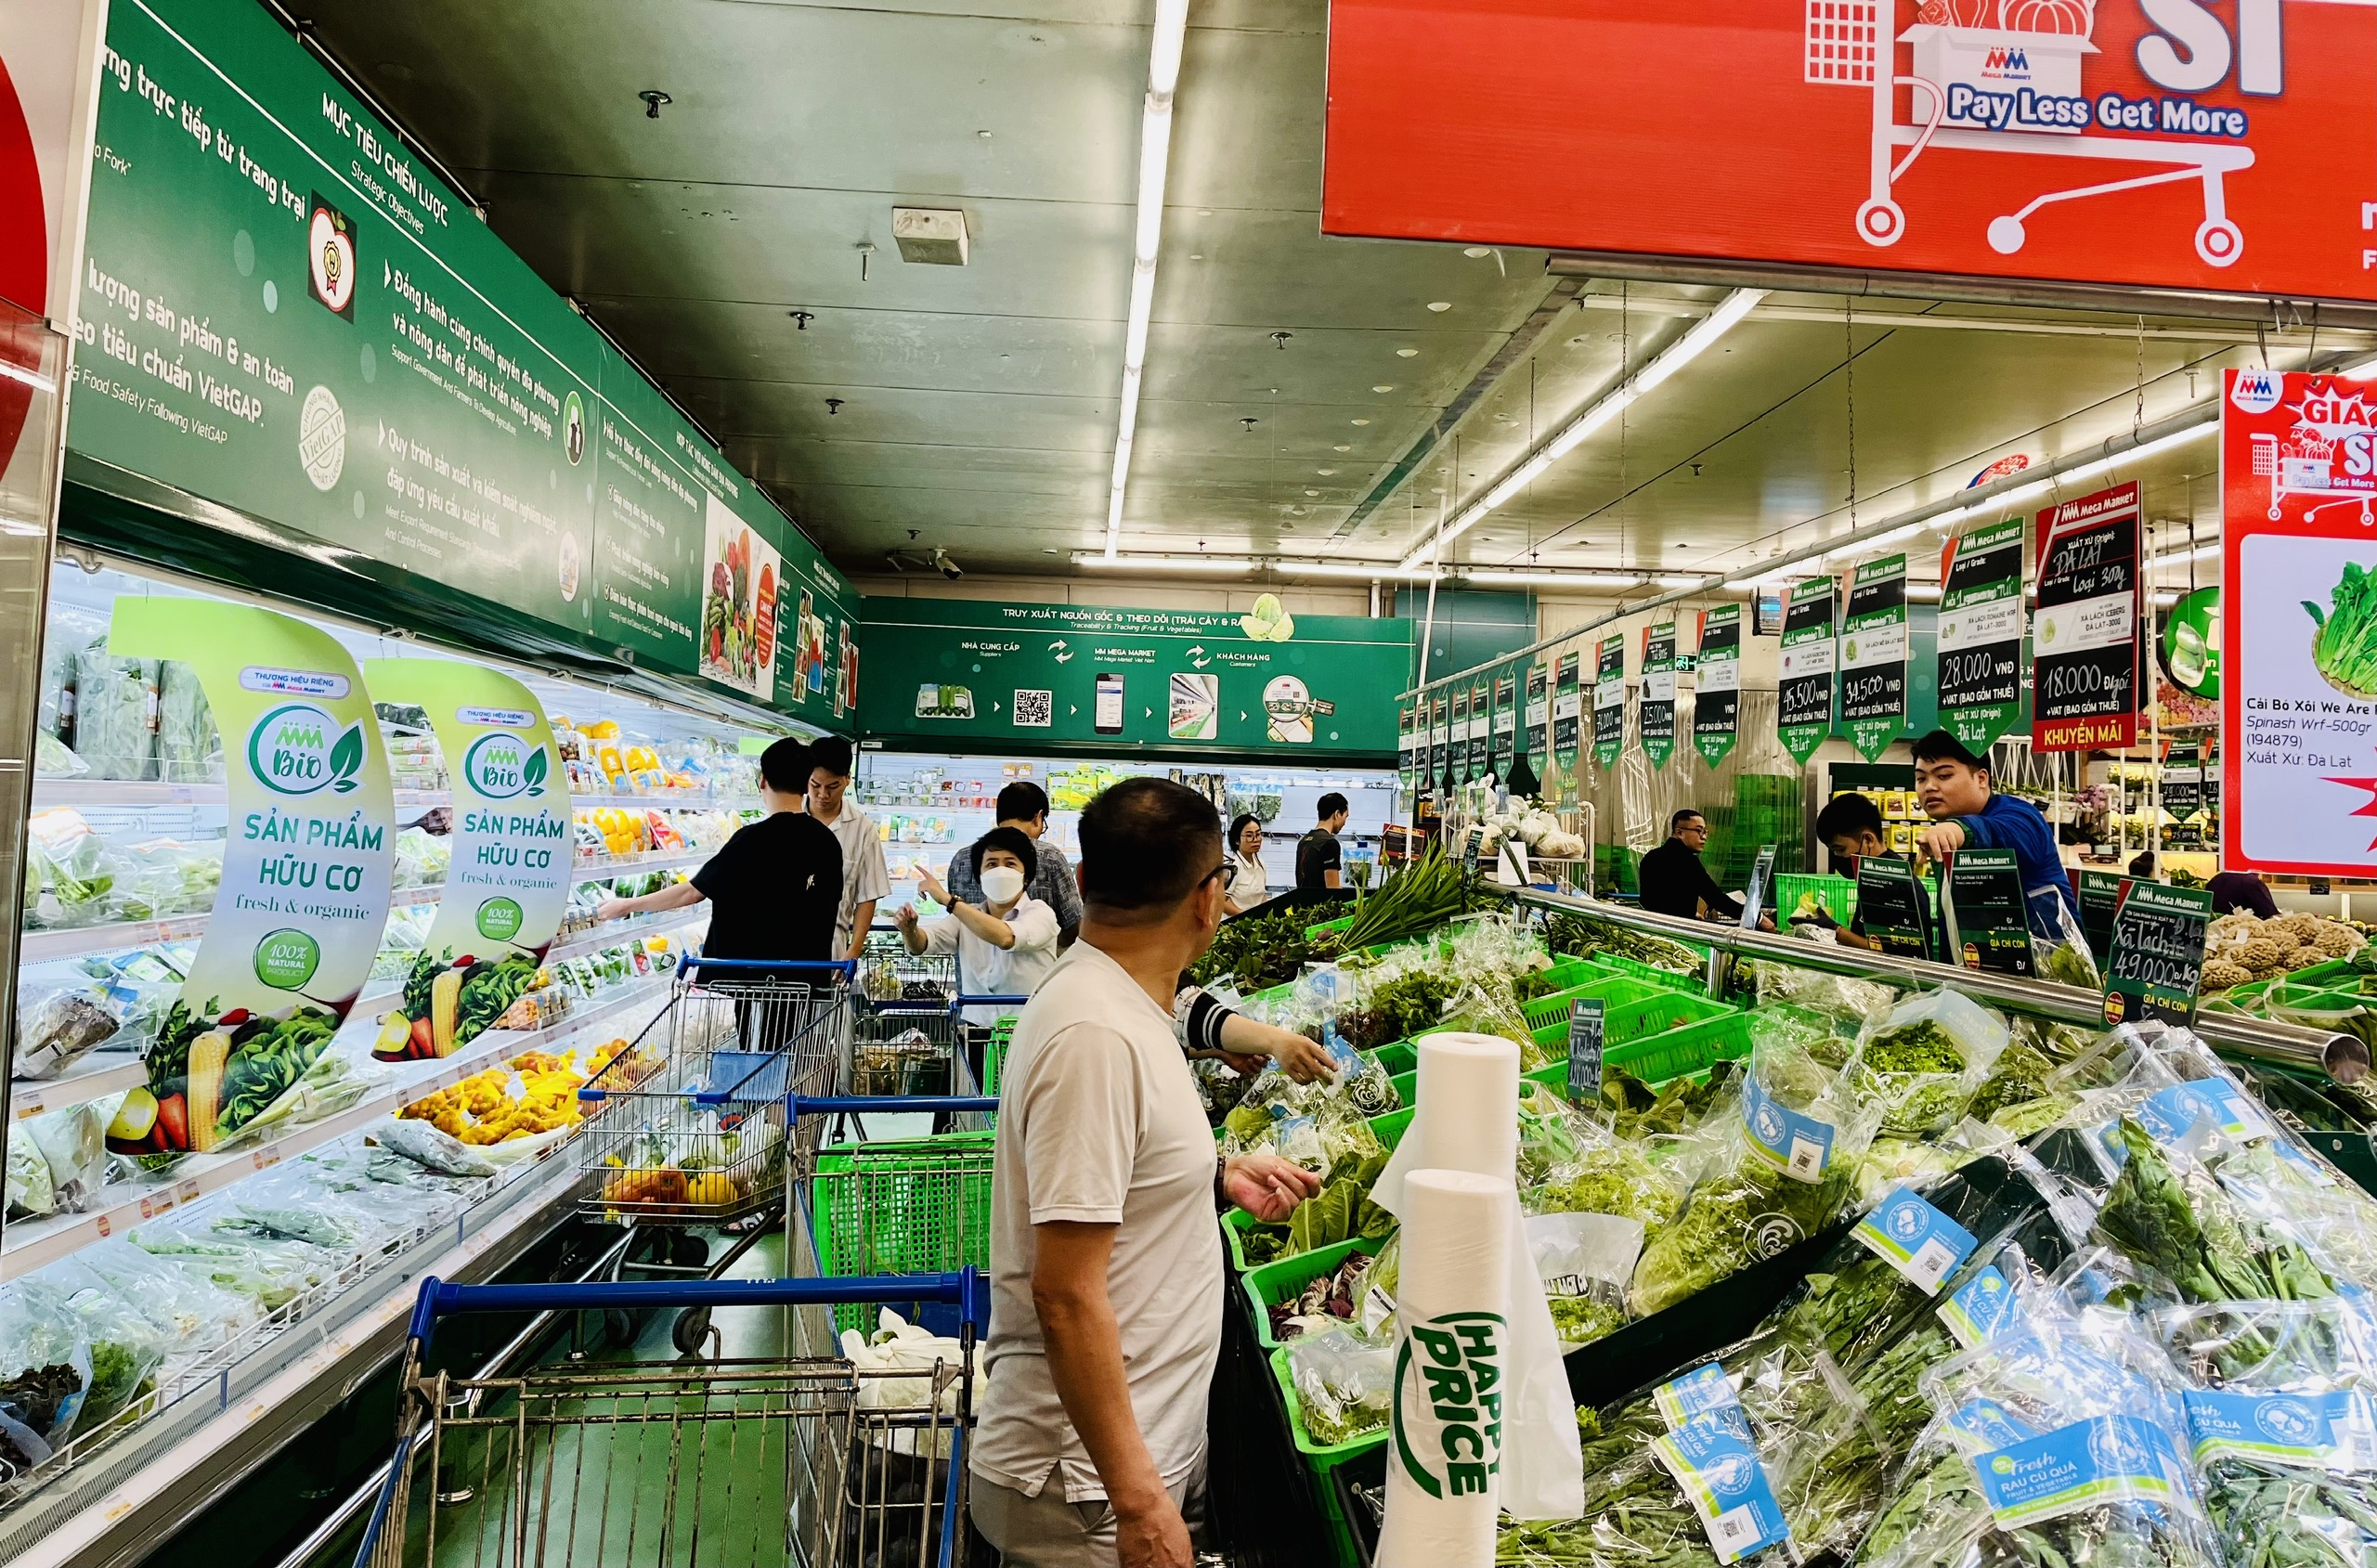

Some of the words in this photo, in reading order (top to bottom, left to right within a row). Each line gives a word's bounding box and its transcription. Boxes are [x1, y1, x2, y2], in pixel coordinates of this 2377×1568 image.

[1950, 85, 2011, 128] Pay
[2020, 88, 2089, 125] Less
[2098, 96, 2153, 129] Get
[2162, 102, 2244, 136] More
[137, 64, 175, 119] trực
[181, 100, 211, 152] tiếp
[216, 128, 234, 163] từ
[239, 146, 278, 204] trang
[281, 180, 305, 222] trại
[323, 92, 351, 138] MỤC
[355, 122, 382, 165] TIÊU
[384, 151, 416, 198] CHIẾN
[419, 182, 448, 227] LƯỢC
[351, 160, 388, 202] Strategic
[388, 193, 424, 235] Objectives
[88, 258, 139, 321] lượng
[146, 296, 175, 332] sản
[180, 317, 223, 358] phẩm
[227, 337, 239, 365] &
[243, 352, 260, 378] an
[264, 357, 295, 396] toàn
[394, 269, 422, 314] Đồng
[423, 292, 448, 328] hành
[449, 317, 472, 351] cùng
[473, 334, 495, 363] chính
[497, 357, 520, 382] quyền
[521, 369, 532, 394] địa
[533, 380, 559, 415] phương
[103, 322, 136, 367] tiêu
[143, 347, 193, 394] chuẩn
[393, 312, 407, 335] và
[409, 324, 434, 359] nông
[435, 339, 452, 367] dân
[454, 354, 466, 377] để
[467, 365, 487, 392] phát
[489, 377, 508, 407] triển
[510, 396, 527, 426] nông
[82, 369, 110, 395] Food
[111, 382, 146, 414] Safety
[147, 398, 188, 434] Following
[191, 418, 228, 444] VietGAP
[2304, 394, 2369, 426] GIÁ
[388, 427, 408, 461] Quy
[410, 438, 433, 470] trình
[434, 453, 449, 478] sản
[451, 463, 471, 488] xuất
[473, 475, 483, 495] và
[2332, 476, 2349, 487] Get
[2351, 477, 2375, 488] More
[387, 466, 405, 499] đáp
[407, 476, 424, 508] ứng
[427, 487, 443, 512] yêu
[445, 492, 461, 520] cầu
[462, 506, 480, 529] xuất
[1003, 608, 1027, 617] TRUY
[1031, 606, 1057, 618] XUẤT
[1060, 609, 1091, 620] NGUỒN
[1095, 609, 1113, 621] GỐC
[1126, 614, 1150, 623] THEO
[1198, 615, 1217, 626] CÂY
[1071, 621, 1105, 630] Traceability
[1114, 624, 1140, 632] Tracking
[1166, 626, 1202, 634] Vegetables)
[961, 641, 978, 650] NHÀ
[980, 642, 1001, 651] CUNG
[1004, 641, 1020, 652] CẤP
[1128, 649, 1156, 657] MARKET
[1216, 652, 1245, 661] KHÁCH
[1246, 653, 1270, 661] HÀNG
[253, 671, 289, 683] THƯƠNG
[290, 674, 308, 686] HIỆU
[309, 676, 334, 688] RIÊNG
[1941, 652, 1992, 690] 28.000
[1994, 660, 2014, 676] VNĐ
[2044, 664, 2101, 699] 18.000
[1783, 679, 1817, 712] 45.500
[1816, 689, 1828, 702] VNĐ
[1845, 674, 1883, 706] 34.500
[1886, 679, 1901, 693] VNĐ
[1942, 694, 1957, 706] +VAT
[1958, 693, 1975, 705] (BAO
[1976, 686, 1992, 702] GỒM
[1993, 681, 2014, 700] THUẾ)
[1644, 705, 1666, 725] 25.000
[2063, 703, 2081, 715] (BAO
[2082, 700, 2098, 713] GỒM
[2098, 699, 2120, 712] THUẾ)
[2246, 697, 2267, 710] Cải
[2294, 700, 2316, 713] Xôi
[2320, 701, 2341, 714] We
[2345, 703, 2371, 715] Are
[2045, 719, 2095, 746] KHUYẾN
[2098, 719, 2122, 743] MÃI
[2246, 715, 2296, 731] Spinash
[2302, 718, 2372, 736] Wrf-500gr
[2246, 733, 2303, 749] (194879)
[273, 748, 322, 780] Bio
[2246, 749, 2278, 764] Xuất
[2308, 753, 2326, 767] Đà
[2331, 755, 2352, 770] Lạt
[483, 766, 518, 788] Bio
[243, 807, 299, 843] SẢN
[306, 810, 383, 851] PHẨM
[464, 808, 504, 835] SẢN
[510, 810, 565, 839] PHẨM
[476, 841, 518, 865] HỮU
[524, 849, 552, 869] CƠ
[258, 852, 318, 889] HỮU
[324, 864, 364, 892] CƠ
[461, 871, 493, 885] fresh
[496, 875, 507, 887] &
[510, 877, 557, 890] organic
[235, 893, 280, 913] fresh
[284, 898, 300, 915] &
[304, 904, 370, 922] organic
[487, 906, 514, 919] 100%
[2153, 893, 2175, 905] Mega
[2175, 896, 2204, 911] Market
[485, 917, 513, 927] NATURAL
[269, 944, 307, 960] 100%
[1990, 937, 2000, 947] GIÁ
[2001, 937, 2011, 948] CHỈ
[2011, 938, 2025, 949] CÒN
[266, 958, 305, 970] NATURAL
[266, 966, 305, 978] PRODUCT
[2114, 950, 2176, 982] 49.000
[2143, 992, 2155, 1005] GIÁ
[2157, 993, 2170, 1008] CHỈ
[2171, 996, 2189, 1013] CÒN
[1411, 1325, 1487, 1497] PRICE
[2009, 1451, 2058, 1477] Fresh
[2001, 1476, 2027, 1493] RAU
